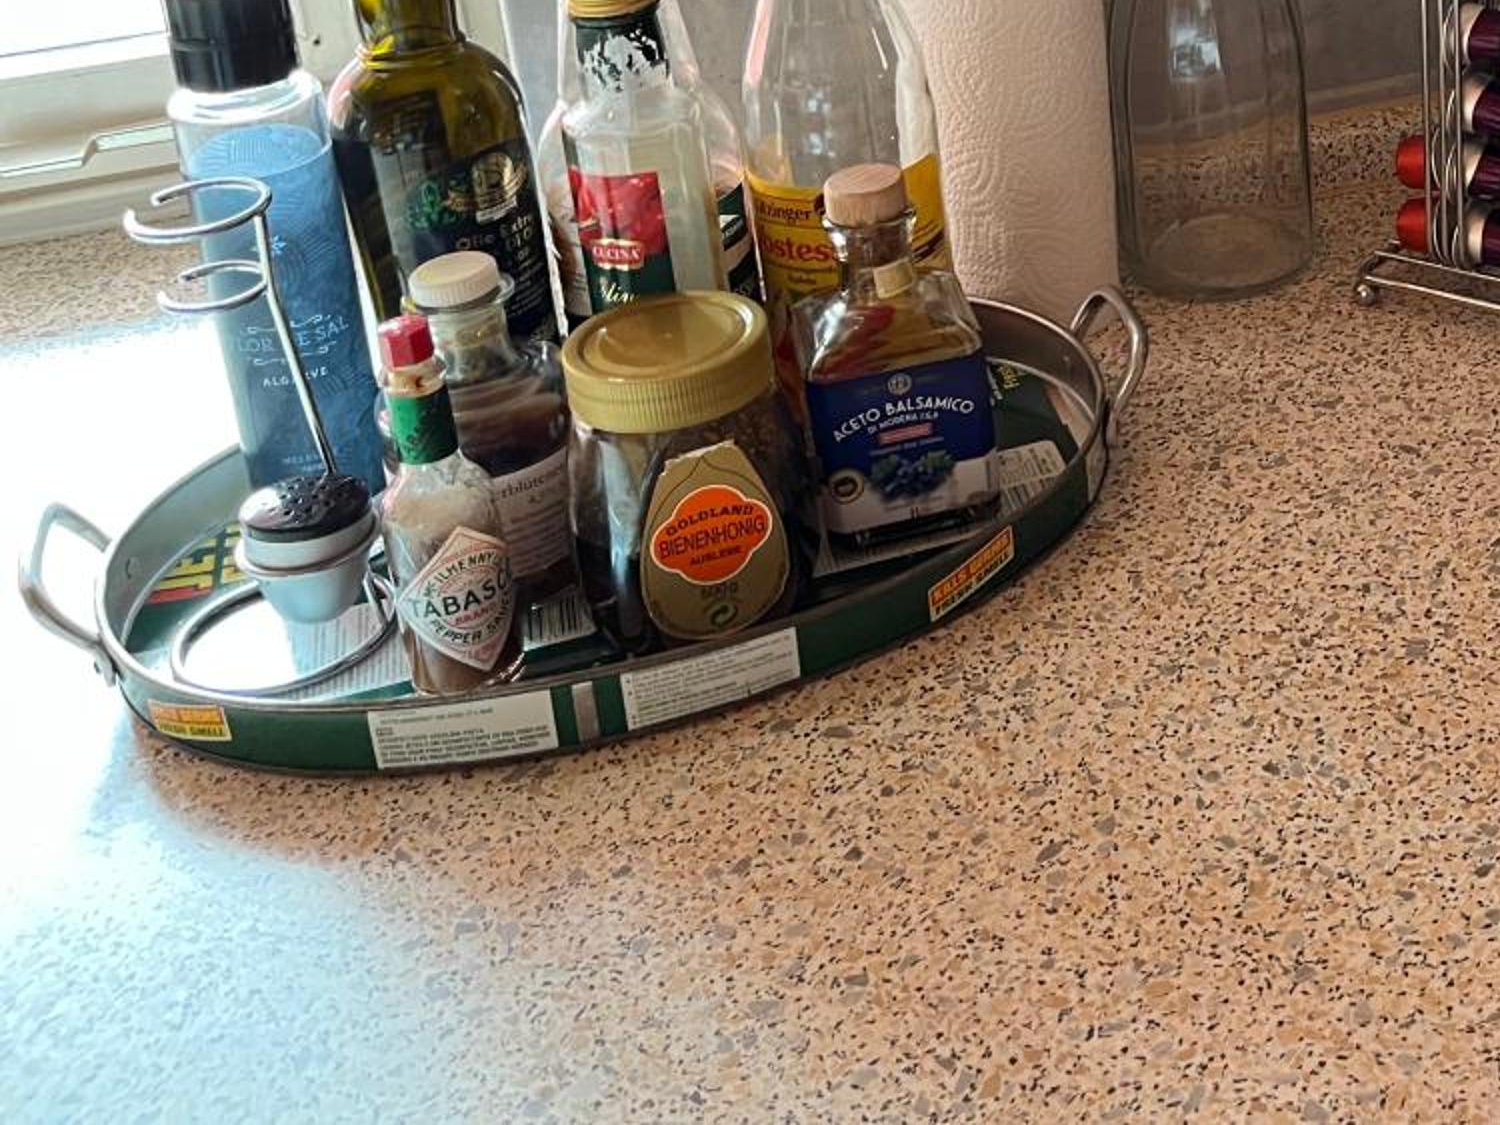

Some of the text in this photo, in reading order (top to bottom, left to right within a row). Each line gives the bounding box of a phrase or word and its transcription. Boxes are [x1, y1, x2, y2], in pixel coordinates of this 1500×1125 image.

[832, 407, 881, 443] ACETO
[885, 396, 976, 416] BALSAMICO
[658, 515, 765, 559] BIENENHONIG
[665, 504, 755, 537] GOLDLAND
[431, 618, 483, 644] PEPPER
